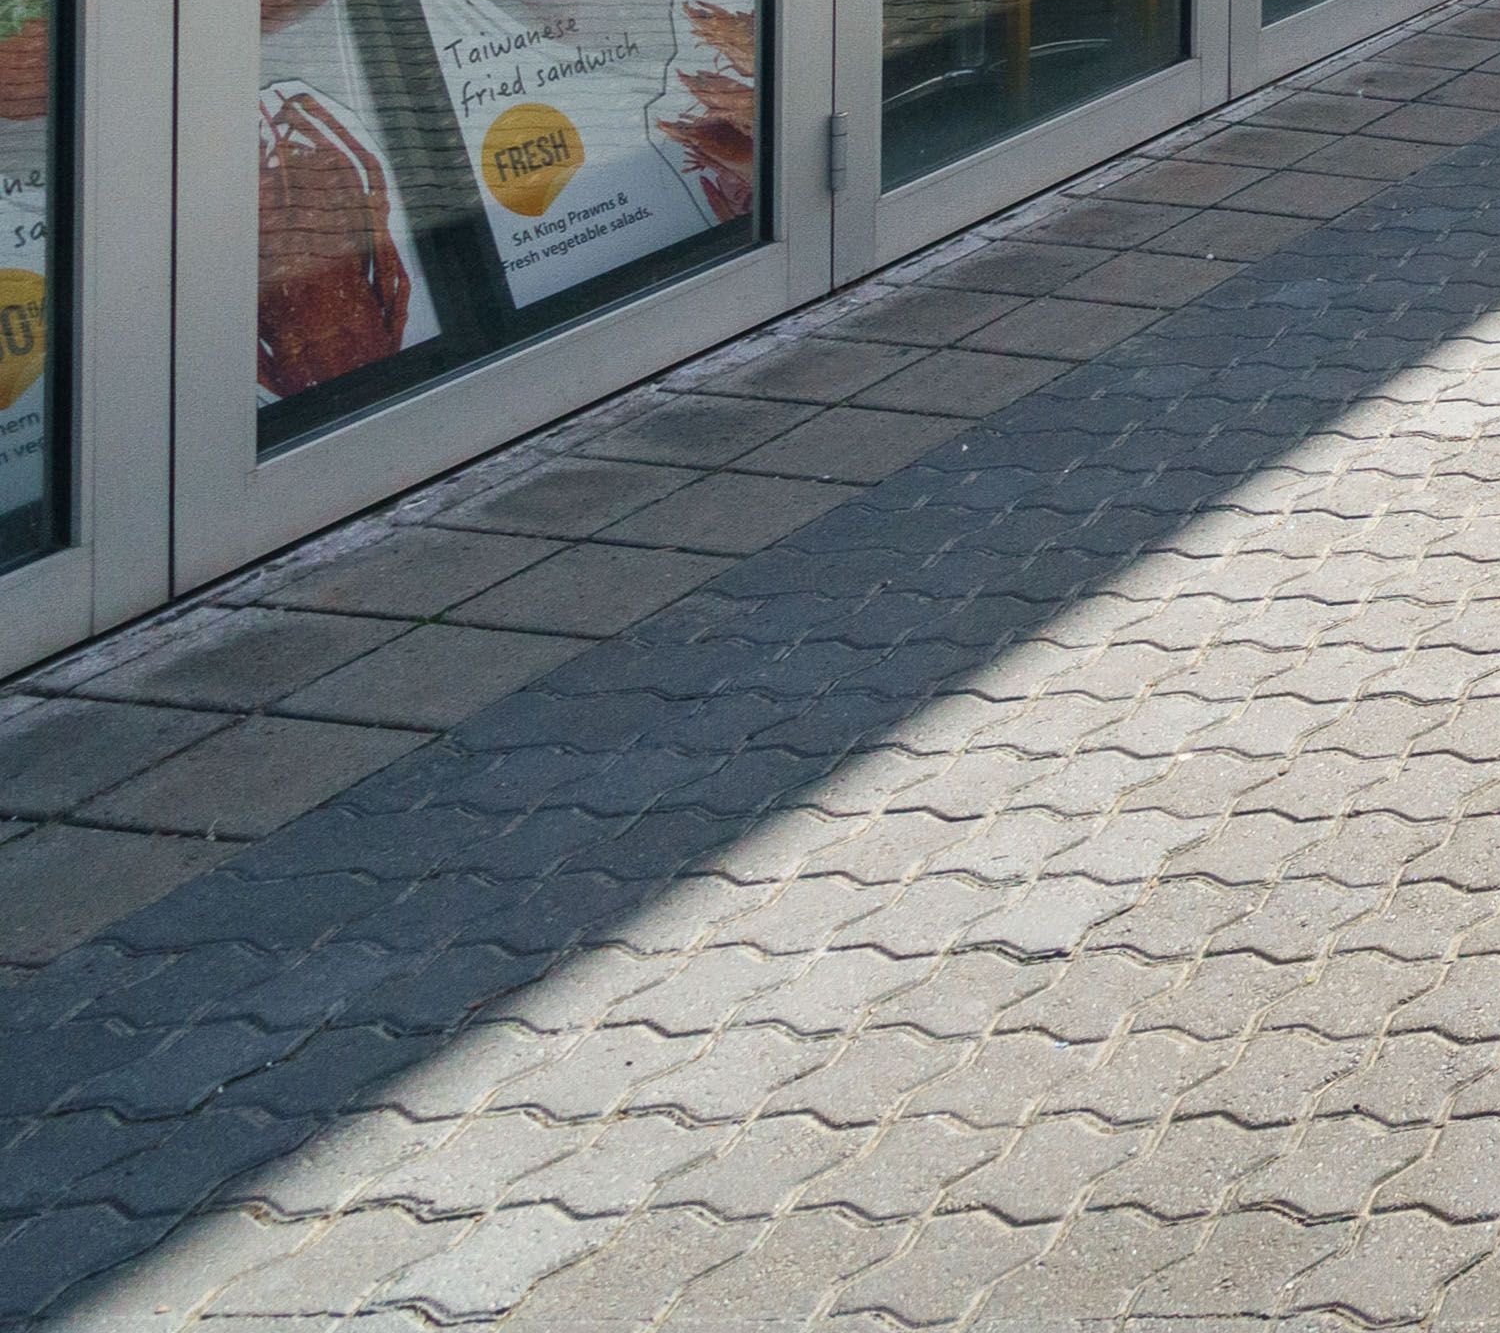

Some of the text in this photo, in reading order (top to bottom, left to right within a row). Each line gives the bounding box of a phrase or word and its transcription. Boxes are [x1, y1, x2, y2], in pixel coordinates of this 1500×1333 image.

[444, 18, 580, 70] Taiwanese
[461, 32, 640, 118] fried sandwich
[494, 130, 571, 183] FRESH
[502, 204, 654, 274] Fresh vegetable salads.
[511, 192, 629, 247] SA King Prawns &
